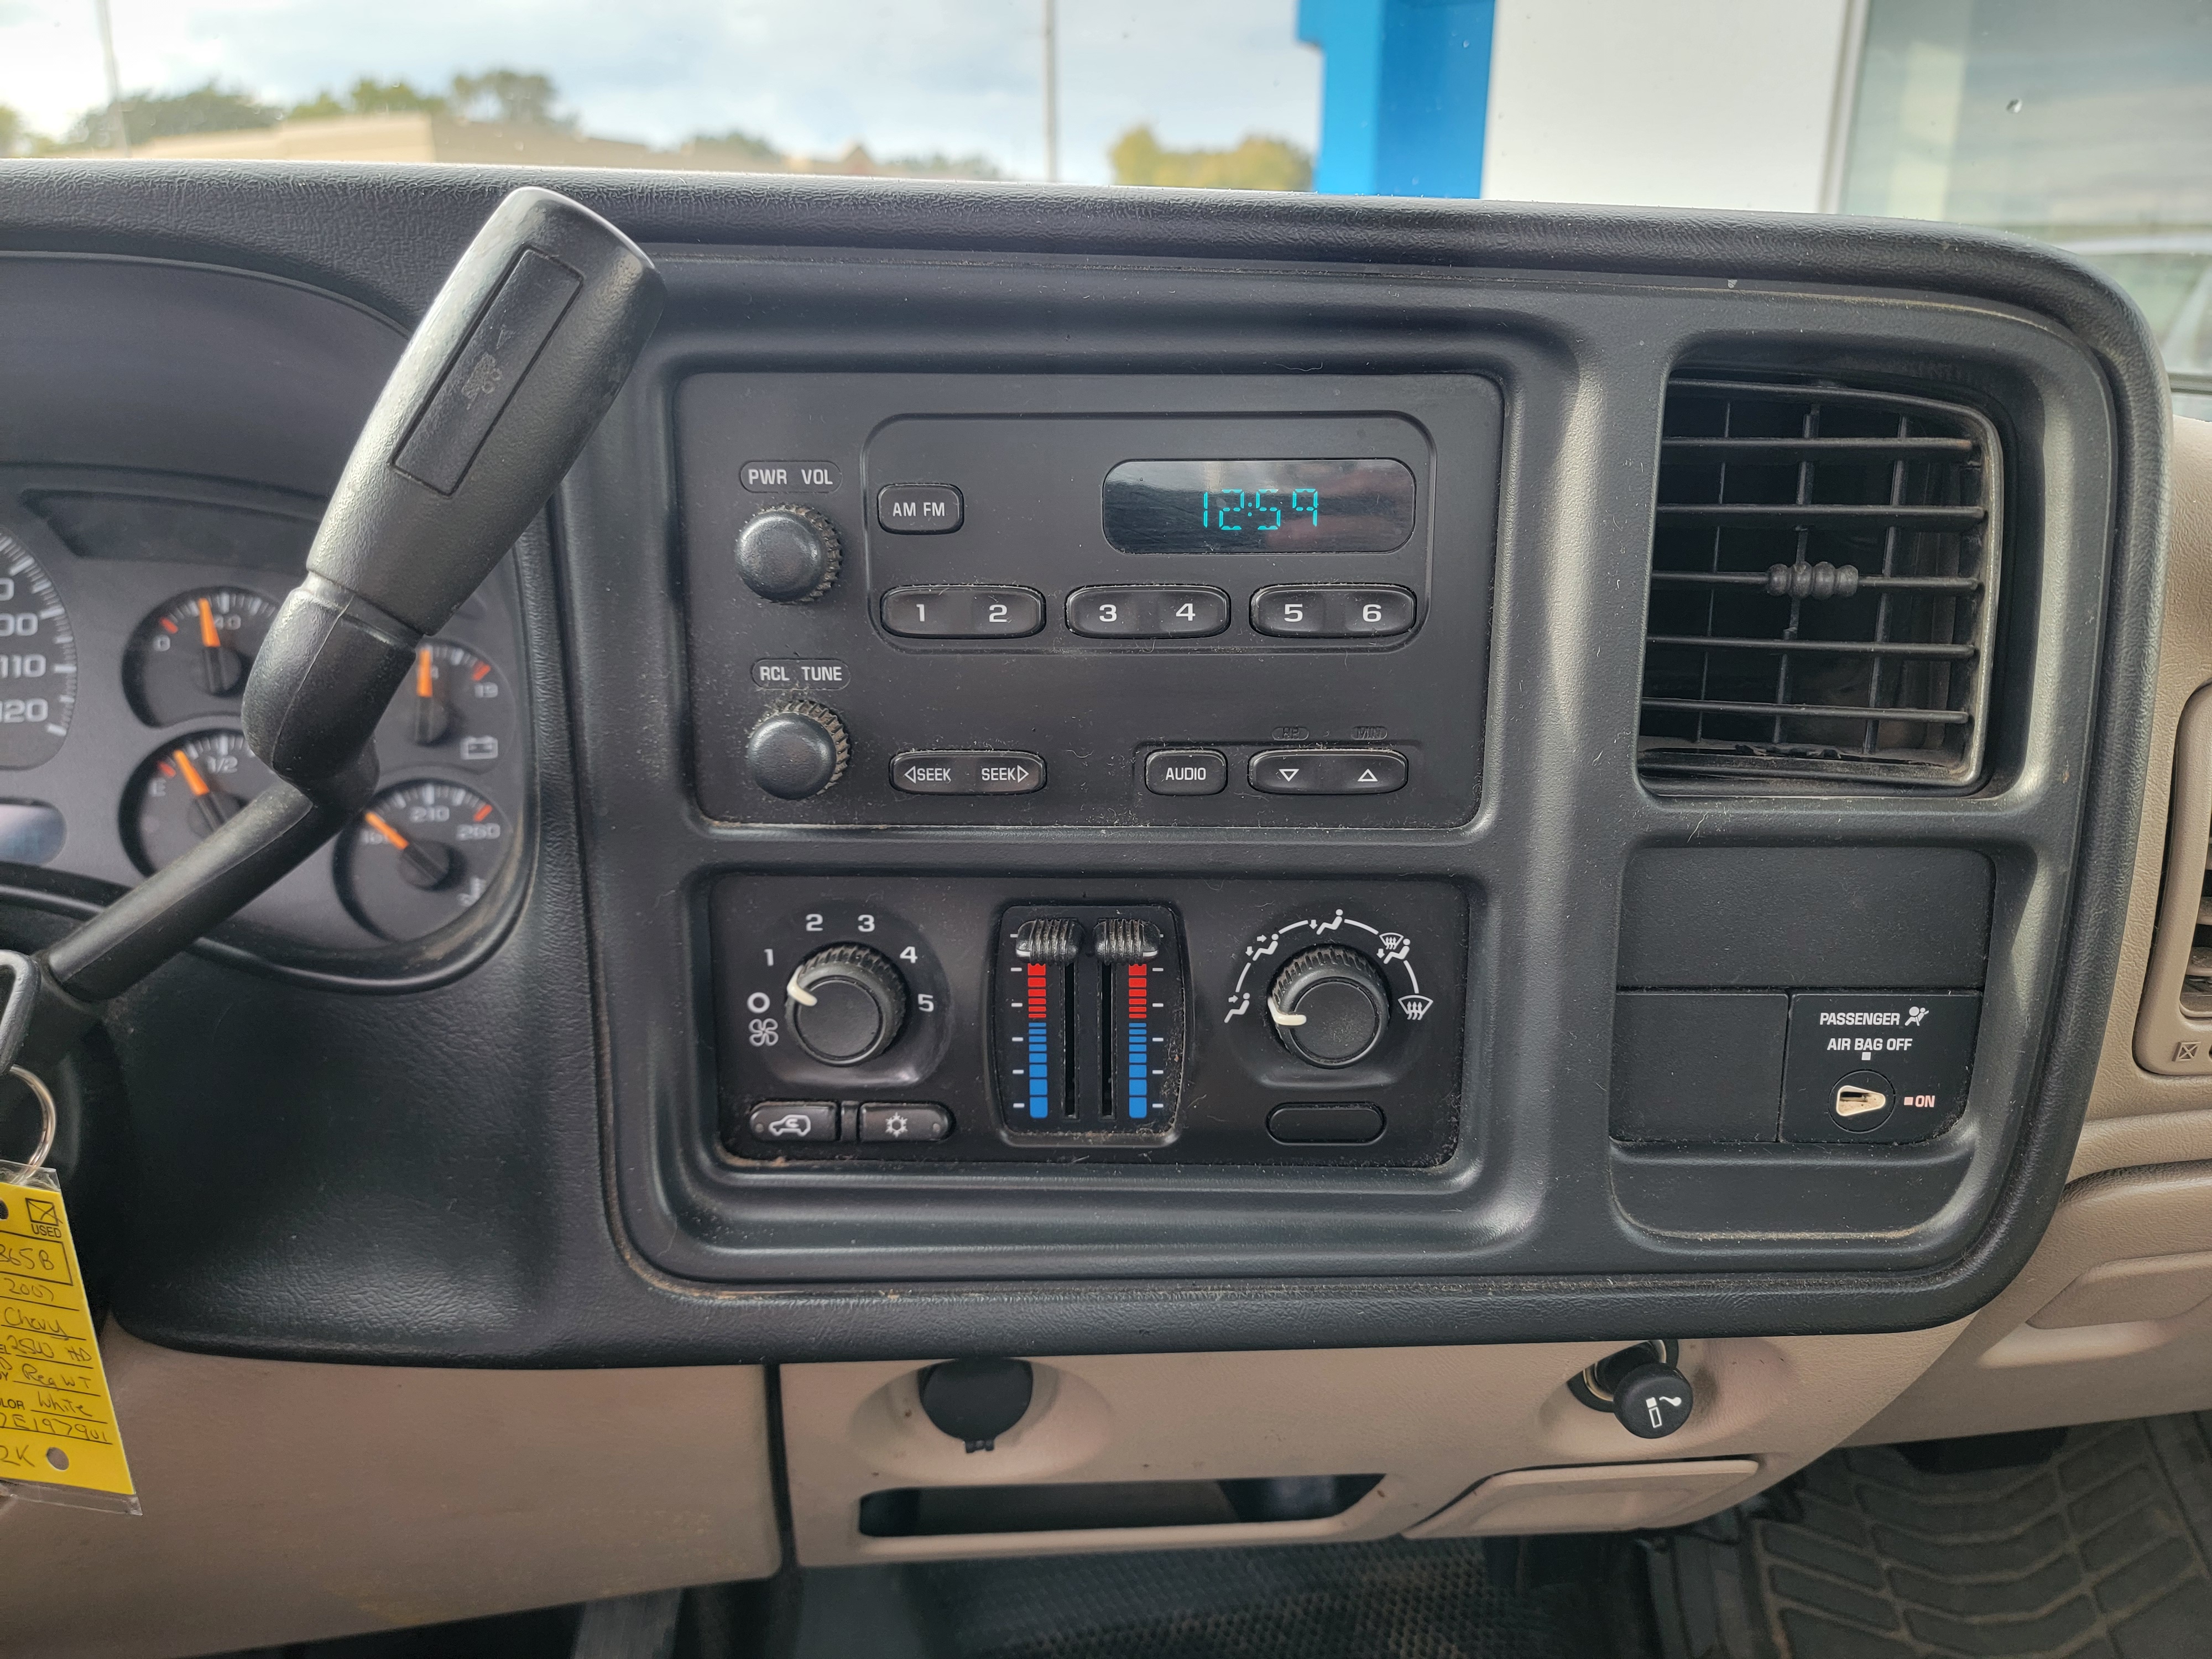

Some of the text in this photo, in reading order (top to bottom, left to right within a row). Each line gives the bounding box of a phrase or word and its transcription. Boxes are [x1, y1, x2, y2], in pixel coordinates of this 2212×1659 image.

[748, 469, 833, 485] PWR VOL
[892, 503, 946, 517] AM FM
[1203, 488, 1318, 531] 12:59
[916, 604, 926, 622] 1
[988, 604, 1008, 623] 2
[1098, 604, 1118, 622] 3
[1175, 603, 1196, 621] 4
[1283, 604, 1303, 622] 5
[1361, 604, 1382, 622] 6
[0, 612, 39, 637] 00
[0, 654, 46, 678] 110
[759, 666, 843, 682] RCL TUNE
[917, 768, 1016, 781] SEEK SEEK
[1165, 767, 1207, 781] AUDIO
[409, 805, 450, 823] 210
[805, 914, 824, 931] 2
[857, 915, 875, 932] 3
[764, 948, 774, 967] 1
[900, 946, 919, 964] 4
[917, 994, 935, 1012] 5
[1819, 1013, 1901, 1026] PASSENGER
[1827, 1038, 1913, 1051] AIR BAG OFF
[1914, 1095, 1936, 1108] ON
[31, 1223, 62, 1238] USED
[0, 1397, 25, 1411] LOR
